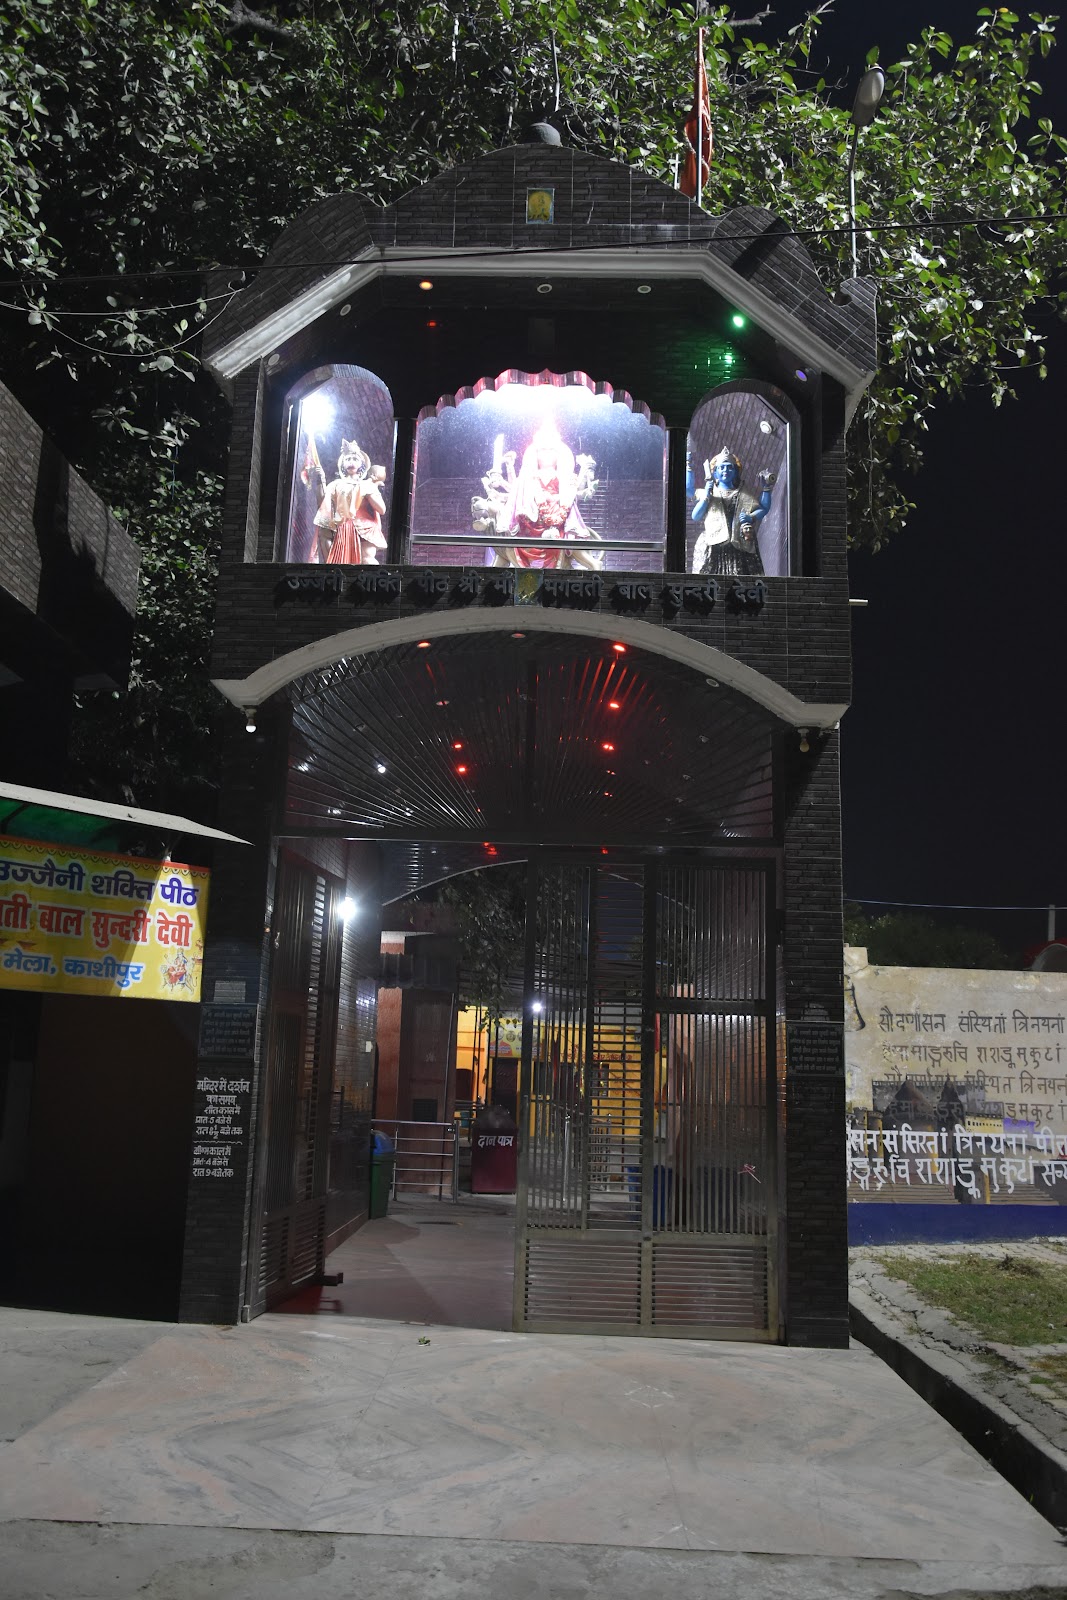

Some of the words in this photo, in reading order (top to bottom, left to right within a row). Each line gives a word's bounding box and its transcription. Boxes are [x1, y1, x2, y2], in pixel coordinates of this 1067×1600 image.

[415, 569, 450, 593] पीठ
[459, 569, 483, 593] श्री
[544, 574, 604, 597] भगवती
[616, 581, 655, 600] बाल
[667, 579, 721, 608] सुन्दरी
[732, 579, 768, 603] देवी
[0, 858, 85, 891] उज्जैनी
[91, 870, 155, 900] शक्ति
[160, 878, 199, 906] पीठ
[0, 894, 32, 929] ती
[38, 905, 85, 936] बाल
[92, 910, 151, 948] सुन्दरी
[157, 912, 193, 947] देवी
[64, 956, 143, 987] काशीपुर
[477, 1135, 497, 1148] दान
[498, 1135, 514, 1147] पात्र
